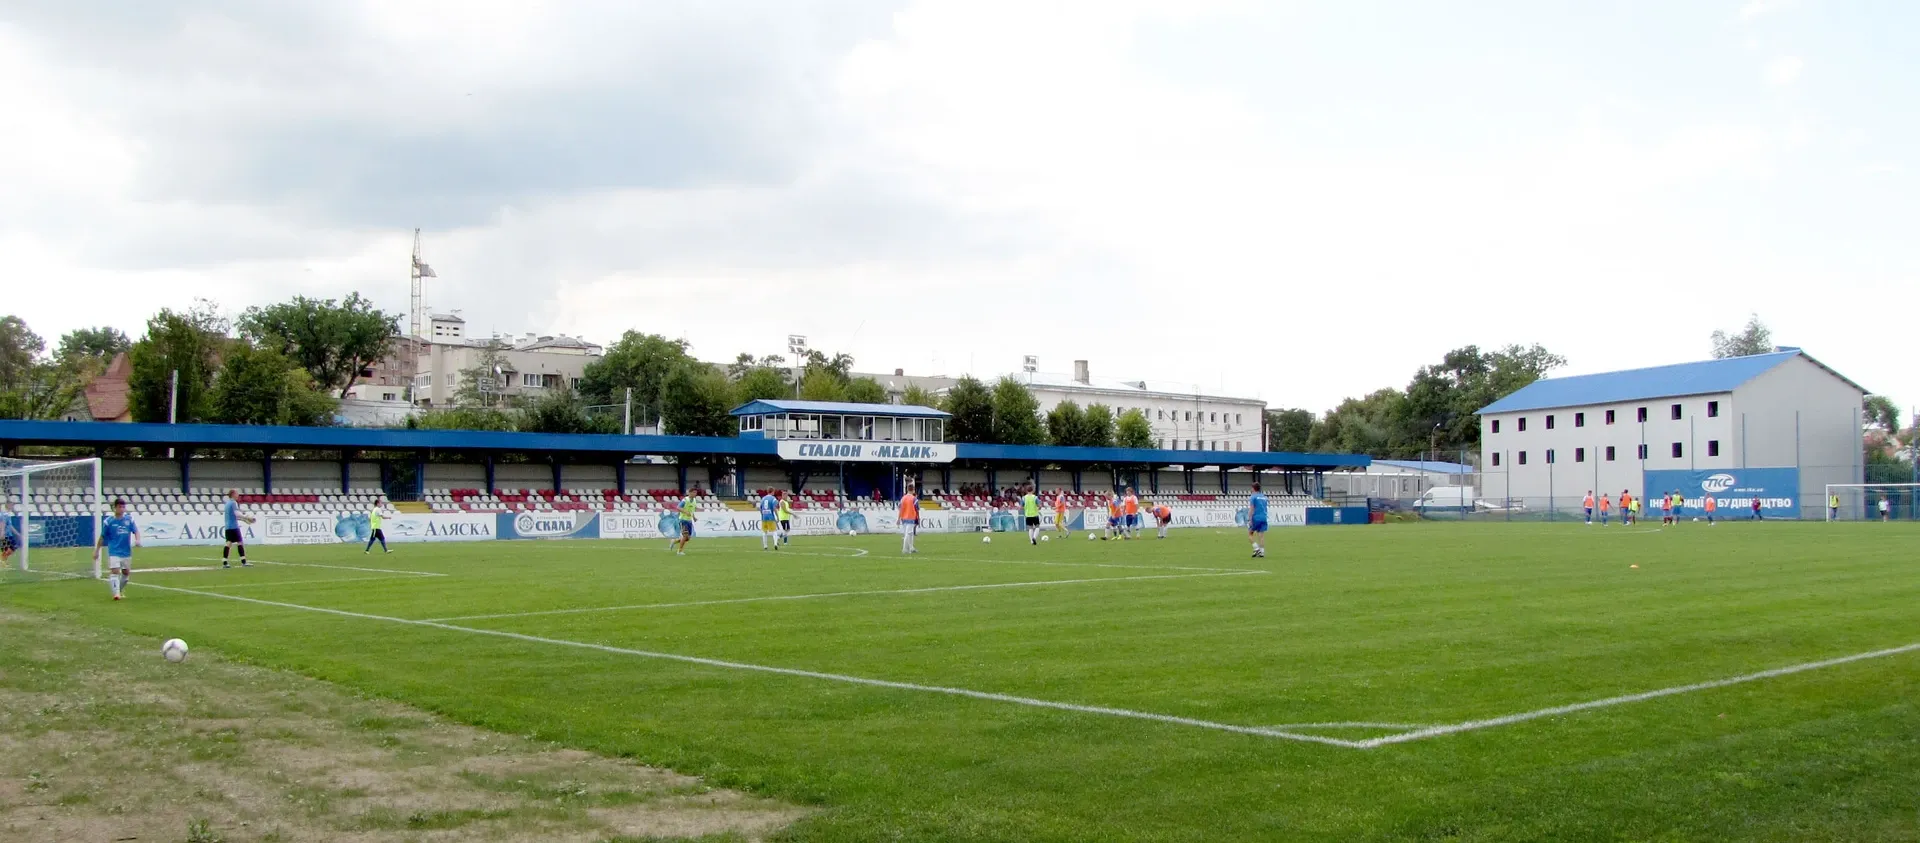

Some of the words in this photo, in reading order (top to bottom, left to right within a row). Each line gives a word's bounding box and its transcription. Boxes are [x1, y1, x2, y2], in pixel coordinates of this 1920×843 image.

[798, 443, 862, 458] СТАДІОН
[871, 445, 938, 459] «МЕДИК»
[535, 520, 573, 531] СКАЛА
[622, 518, 653, 529] НОВА
[805, 516, 832, 526] НОВА
[290, 521, 328, 533] НОВА
[424, 520, 490, 536] АЛЯСКА
